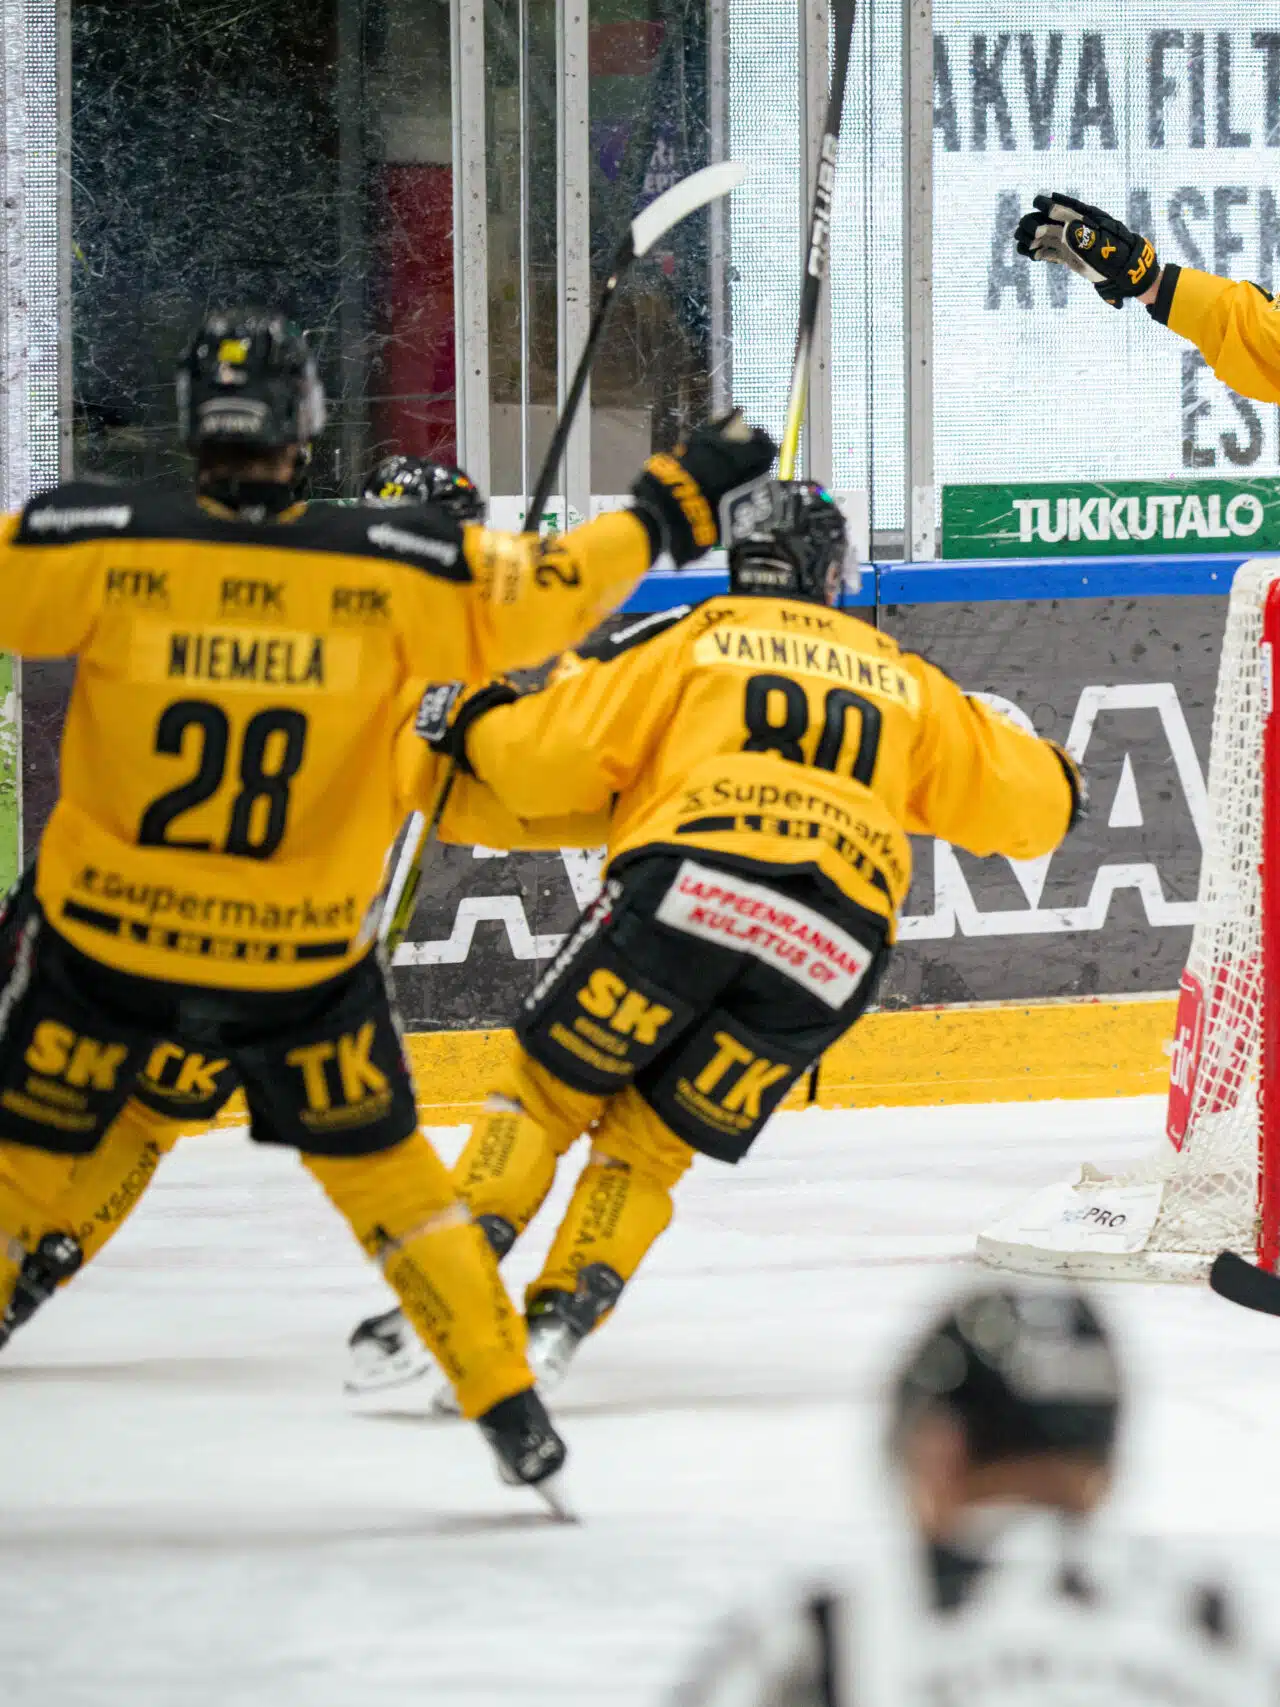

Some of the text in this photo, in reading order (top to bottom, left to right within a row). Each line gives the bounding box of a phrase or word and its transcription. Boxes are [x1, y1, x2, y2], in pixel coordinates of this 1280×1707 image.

[1012, 494, 1264, 543] TUKKUTALO
[740, 673, 883, 789] 80
[136, 699, 308, 861] 28
[576, 967, 674, 1046] SK
[25, 1019, 128, 1092] SK
[286, 1020, 390, 1112] TK
[694, 1031, 792, 1119] TK
[1082, 1207, 1127, 1229] PRO
